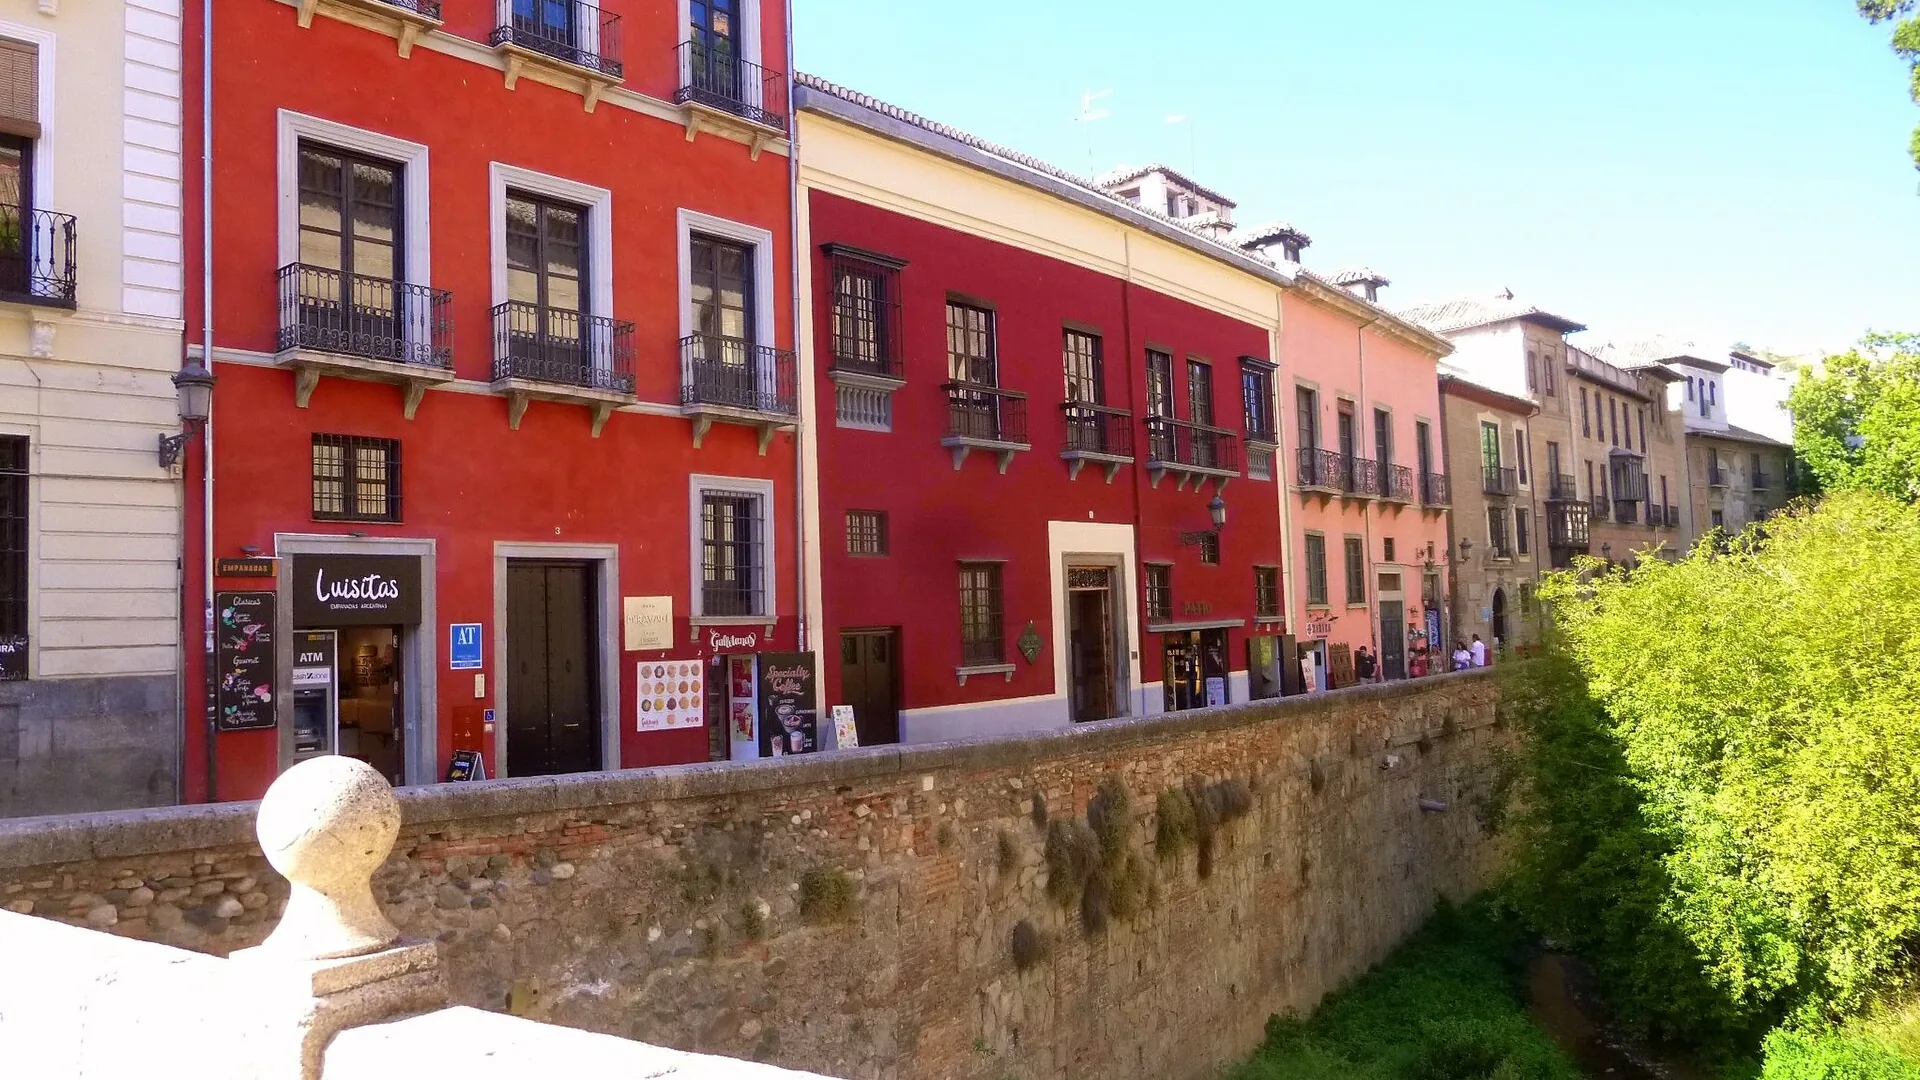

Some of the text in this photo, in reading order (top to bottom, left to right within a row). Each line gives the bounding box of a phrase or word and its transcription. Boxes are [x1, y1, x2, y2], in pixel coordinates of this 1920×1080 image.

[555, 526, 561, 535] 3
[222, 564, 268, 572] EMPANADAS
[316, 568, 399, 602] Luisitas
[457, 627, 476, 645] AT
[299, 652, 324, 662] ATM
[765, 664, 811, 682] Specialty
[772, 678, 805, 695] Coffee
